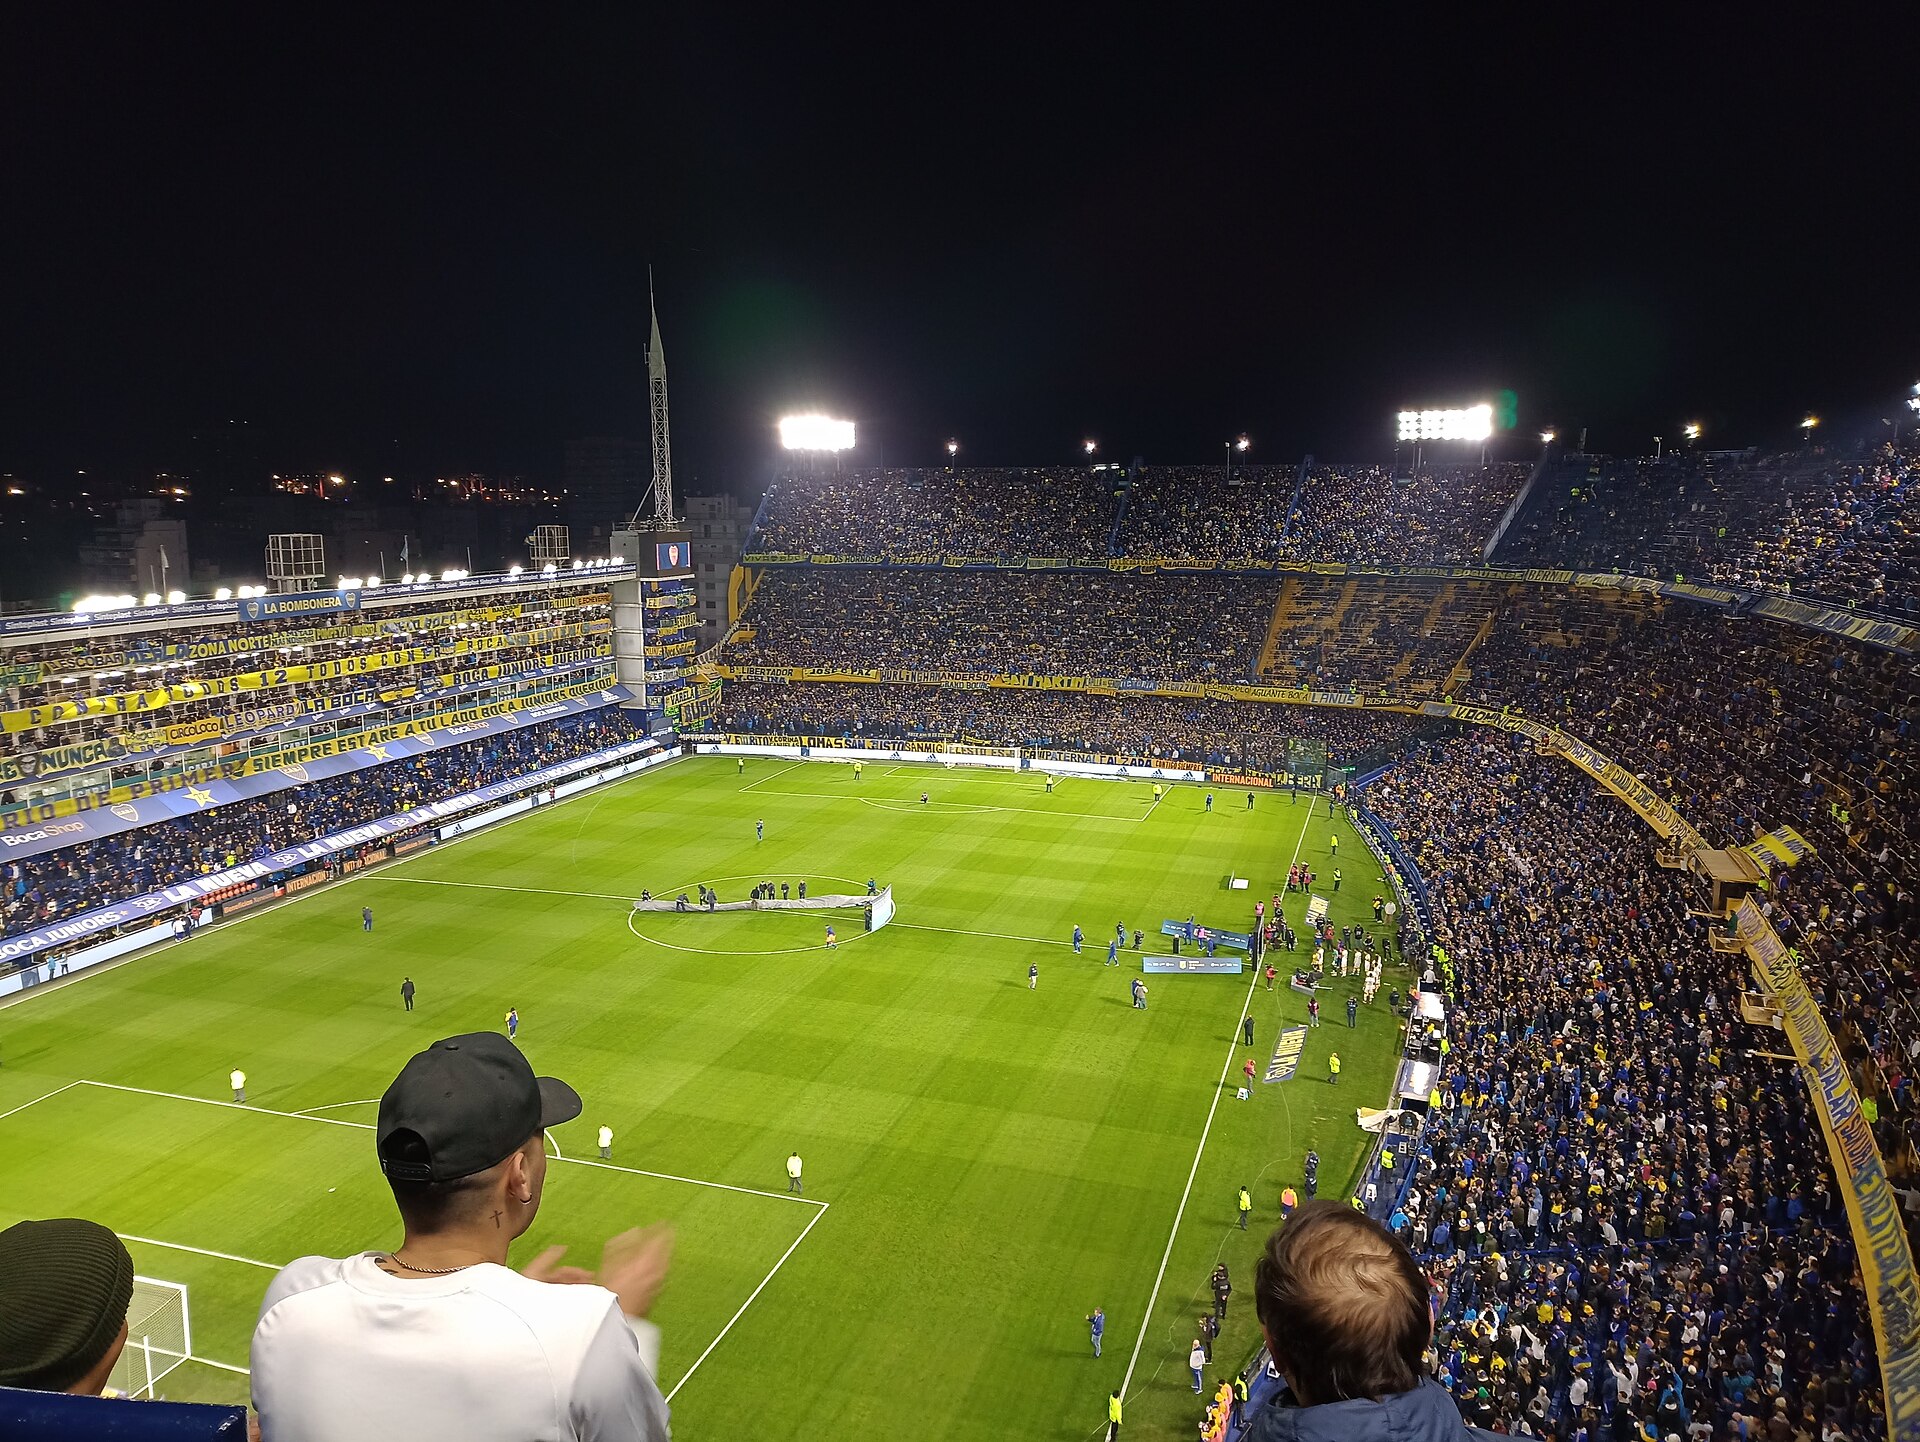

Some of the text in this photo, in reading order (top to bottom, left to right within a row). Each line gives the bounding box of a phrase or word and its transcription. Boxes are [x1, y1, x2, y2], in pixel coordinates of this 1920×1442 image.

[134, 607, 169, 617] Sinteplast
[172, 603, 205, 613] Sinteplast
[207, 602, 239, 611] Sinteplast
[264, 597, 342, 614] LA BOMBONERA
[94, 610, 131, 621] Sinteplast
[5, 619, 49, 630] Sinteplast
[188, 641, 226, 659] ZONA
[228, 633, 270, 653] NORTE
[59, 653, 123, 670] ESCOBAR
[453, 668, 489, 685] BOCA
[497, 656, 547, 677] JUNIORS
[552, 647, 597, 665] QUERIDO
[259, 669, 288, 687] 12
[306, 656, 367, 680] TODOS
[941, 672, 996, 682] ANDERSON
[1251, 689, 1308, 702] AGUANTE BOCA
[223, 704, 295, 728] LEOPARD
[253, 743, 332, 772] SIEMPRE
[337, 726, 400, 752] ESTARE
[405, 723, 416, 735] A
[418, 718, 437, 732] TU
[482, 701, 518, 718] BOCA
[520, 690, 567, 709] JUNIORS
[569, 677, 612, 697] QUERIDO
[170, 722, 219, 740] CIRCOLOCO
[800, 736, 843, 749] LOMAS
[41, 742, 106, 771] NUNCA
[490, 781, 516, 796] CLUB
[1212, 773, 1274, 788] INTERNACIONAL
[296, 842, 329, 859] LA
[323, 823, 389, 851] NUEVA
[162, 882, 200, 903] LA
[194, 860, 272, 893] NUEVA
[286, 871, 330, 893] INTERNACION
[44, 910, 121, 942] JUNIORS
